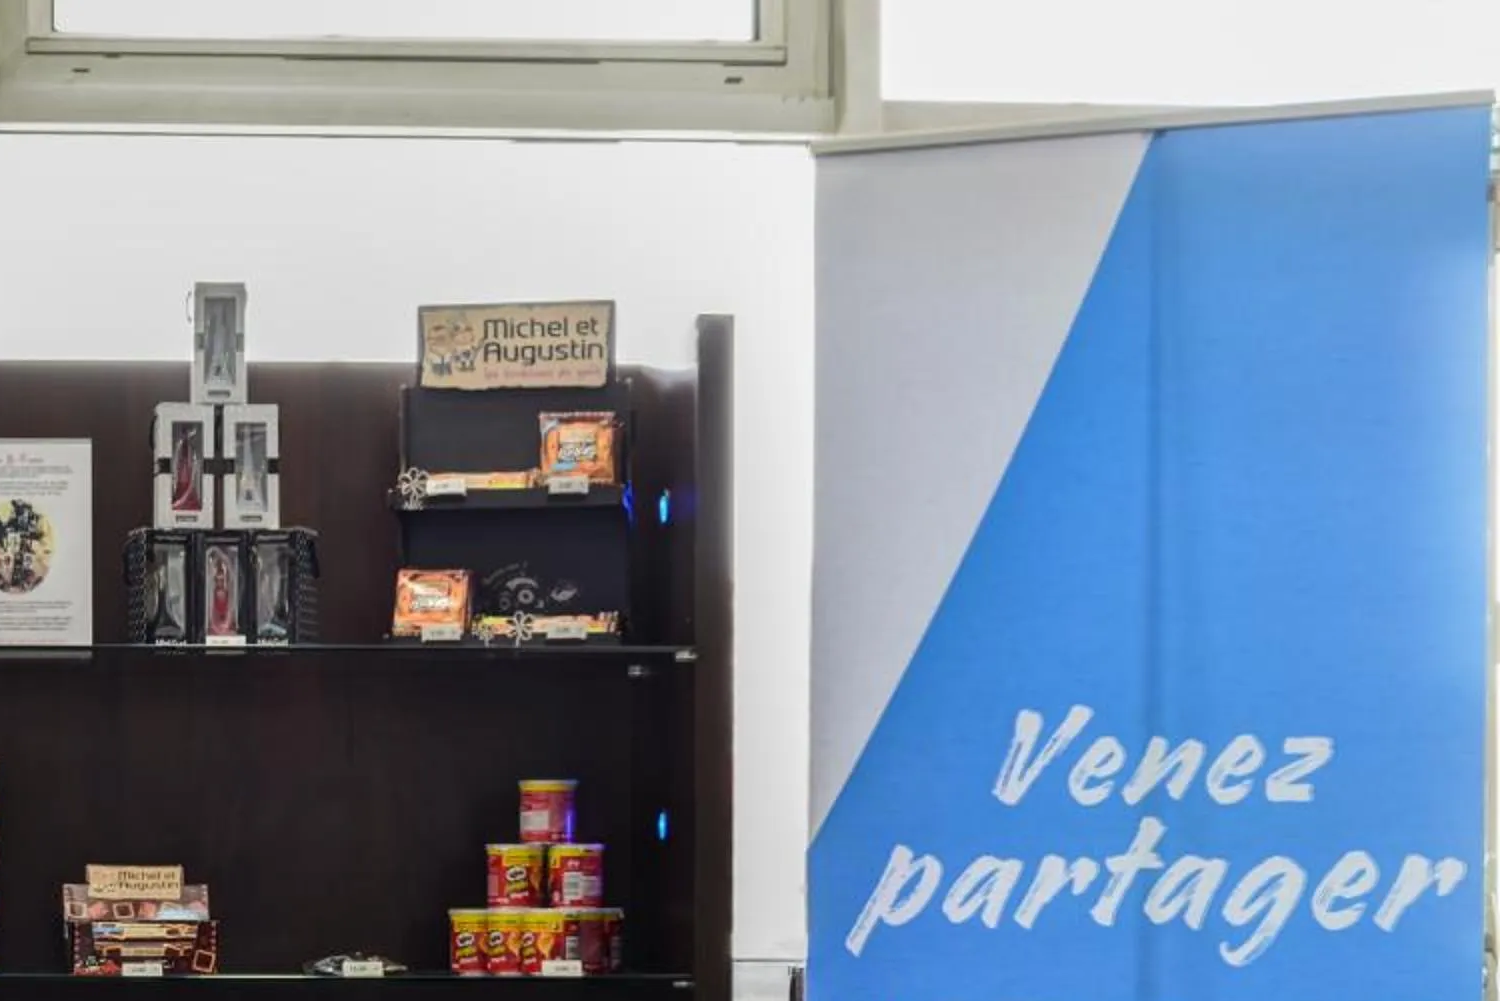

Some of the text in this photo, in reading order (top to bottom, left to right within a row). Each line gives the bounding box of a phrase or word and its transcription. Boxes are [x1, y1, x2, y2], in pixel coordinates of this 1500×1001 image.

[483, 316, 599, 340] Michel et
[483, 339, 603, 366] Augustin
[991, 704, 1336, 806] Venez
[845, 816, 1467, 966] partager
